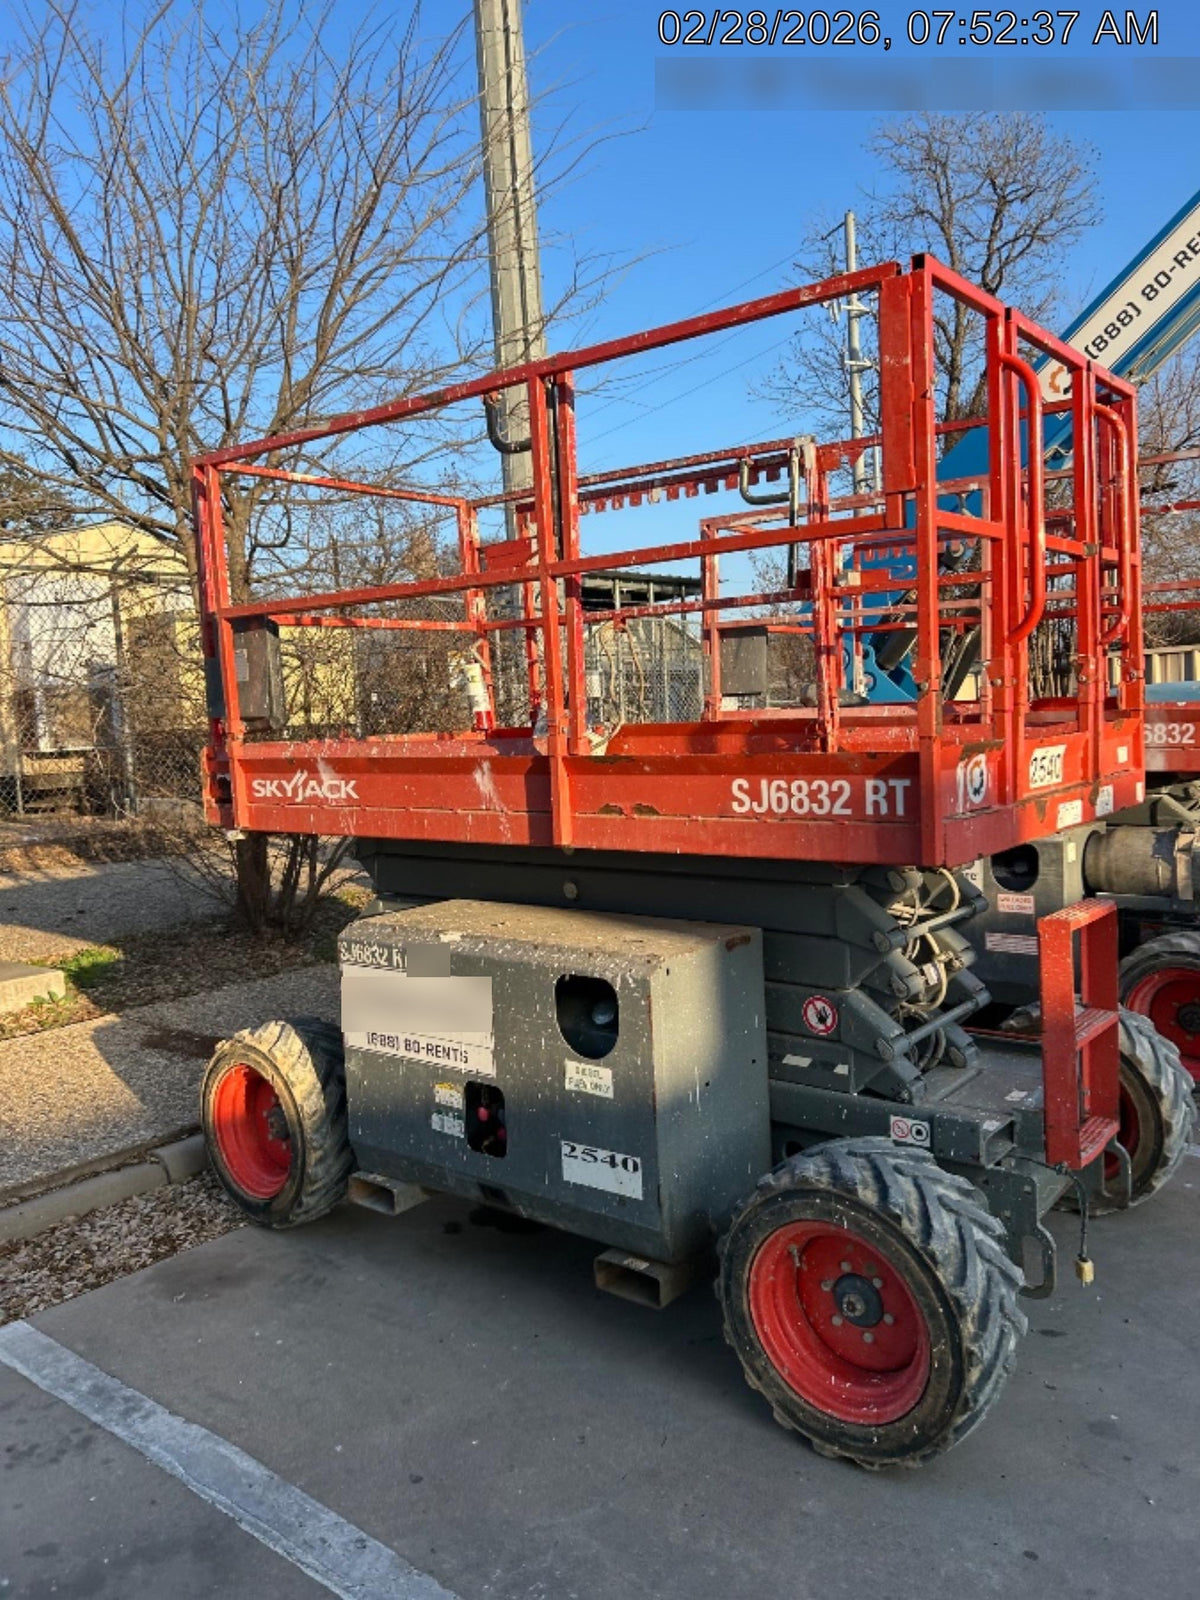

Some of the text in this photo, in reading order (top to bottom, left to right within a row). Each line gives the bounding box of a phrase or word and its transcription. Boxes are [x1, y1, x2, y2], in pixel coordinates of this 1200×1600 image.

[1084, 232, 1200, 360] (888) 80-RE
[251, 768, 360, 803] SKYJACK
[731, 778, 911, 816] SJ6832 RT
[392, 945, 408, 969] R
[404, 1037, 469, 1065] 80-RENTS
[563, 1142, 640, 1174] 2540
